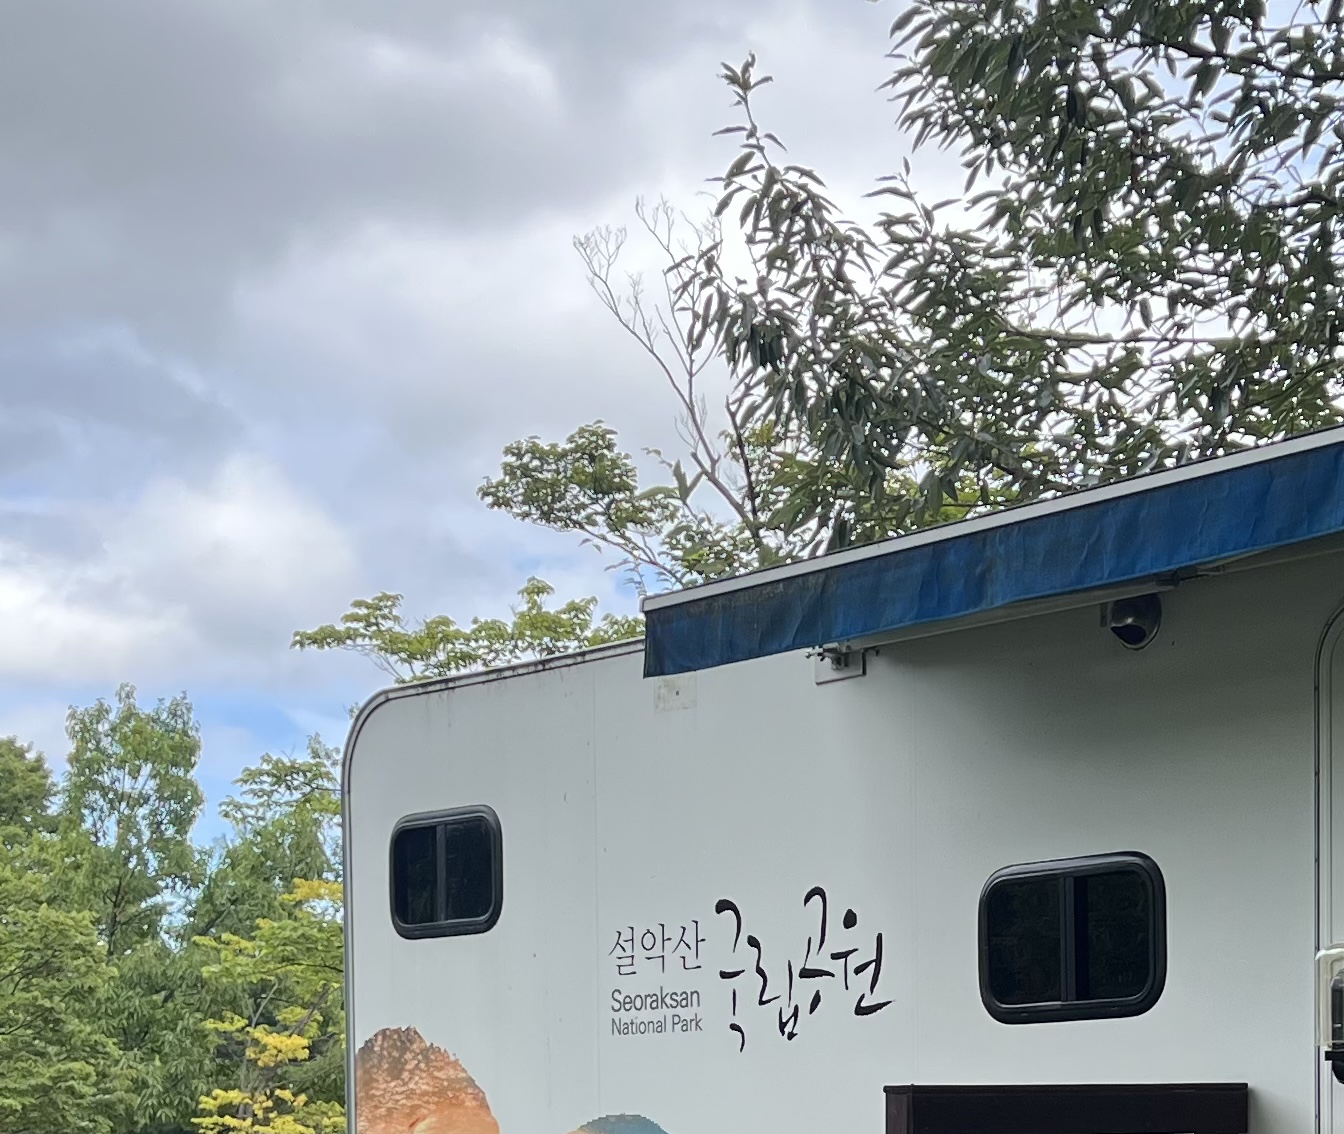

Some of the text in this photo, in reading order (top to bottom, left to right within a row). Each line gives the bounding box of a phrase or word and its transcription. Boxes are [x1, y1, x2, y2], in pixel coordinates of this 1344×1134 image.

[608, 886, 896, 1053] 설악산 국립공원
[610, 985, 701, 1013] Seoraksan
[611, 1011, 704, 1037] National Park
